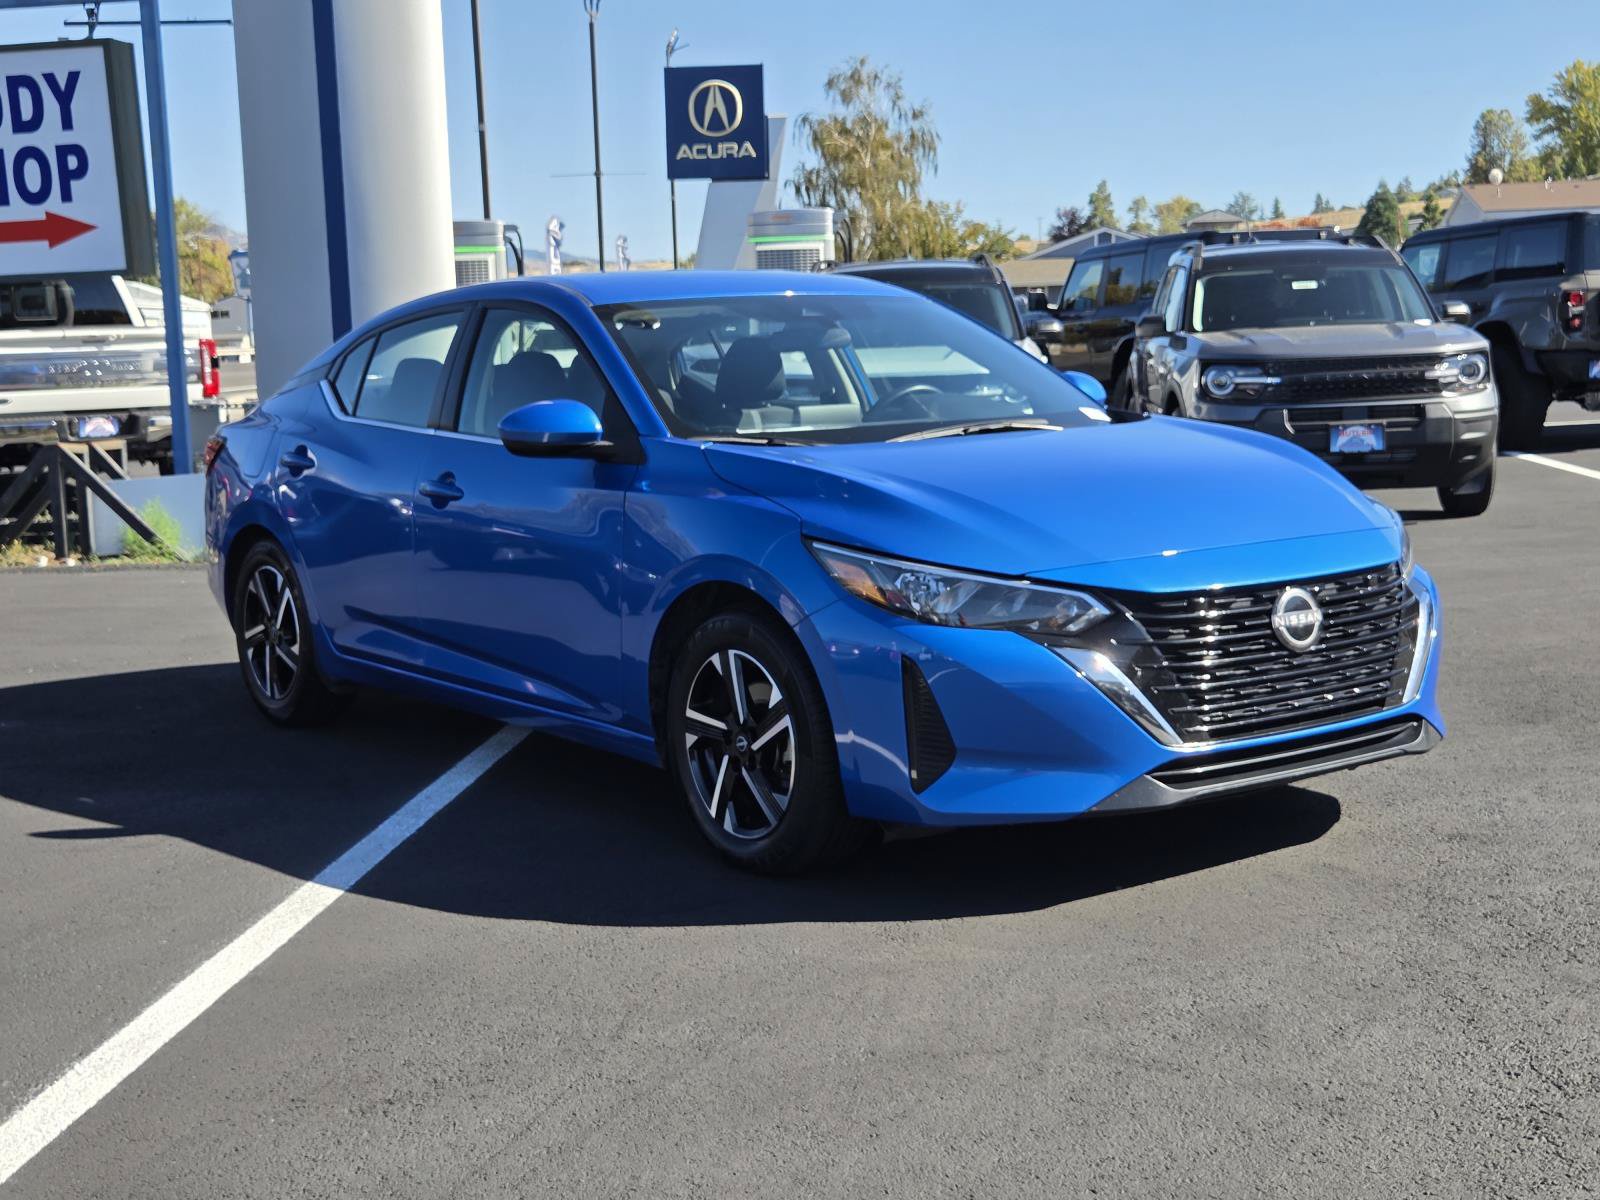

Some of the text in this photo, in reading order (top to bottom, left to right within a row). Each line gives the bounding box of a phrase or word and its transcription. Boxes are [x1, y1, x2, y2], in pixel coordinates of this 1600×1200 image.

[0, 71, 81, 134] DY
[676, 141, 756, 160] ACURA
[1275, 611, 1321, 628] NISSAN
